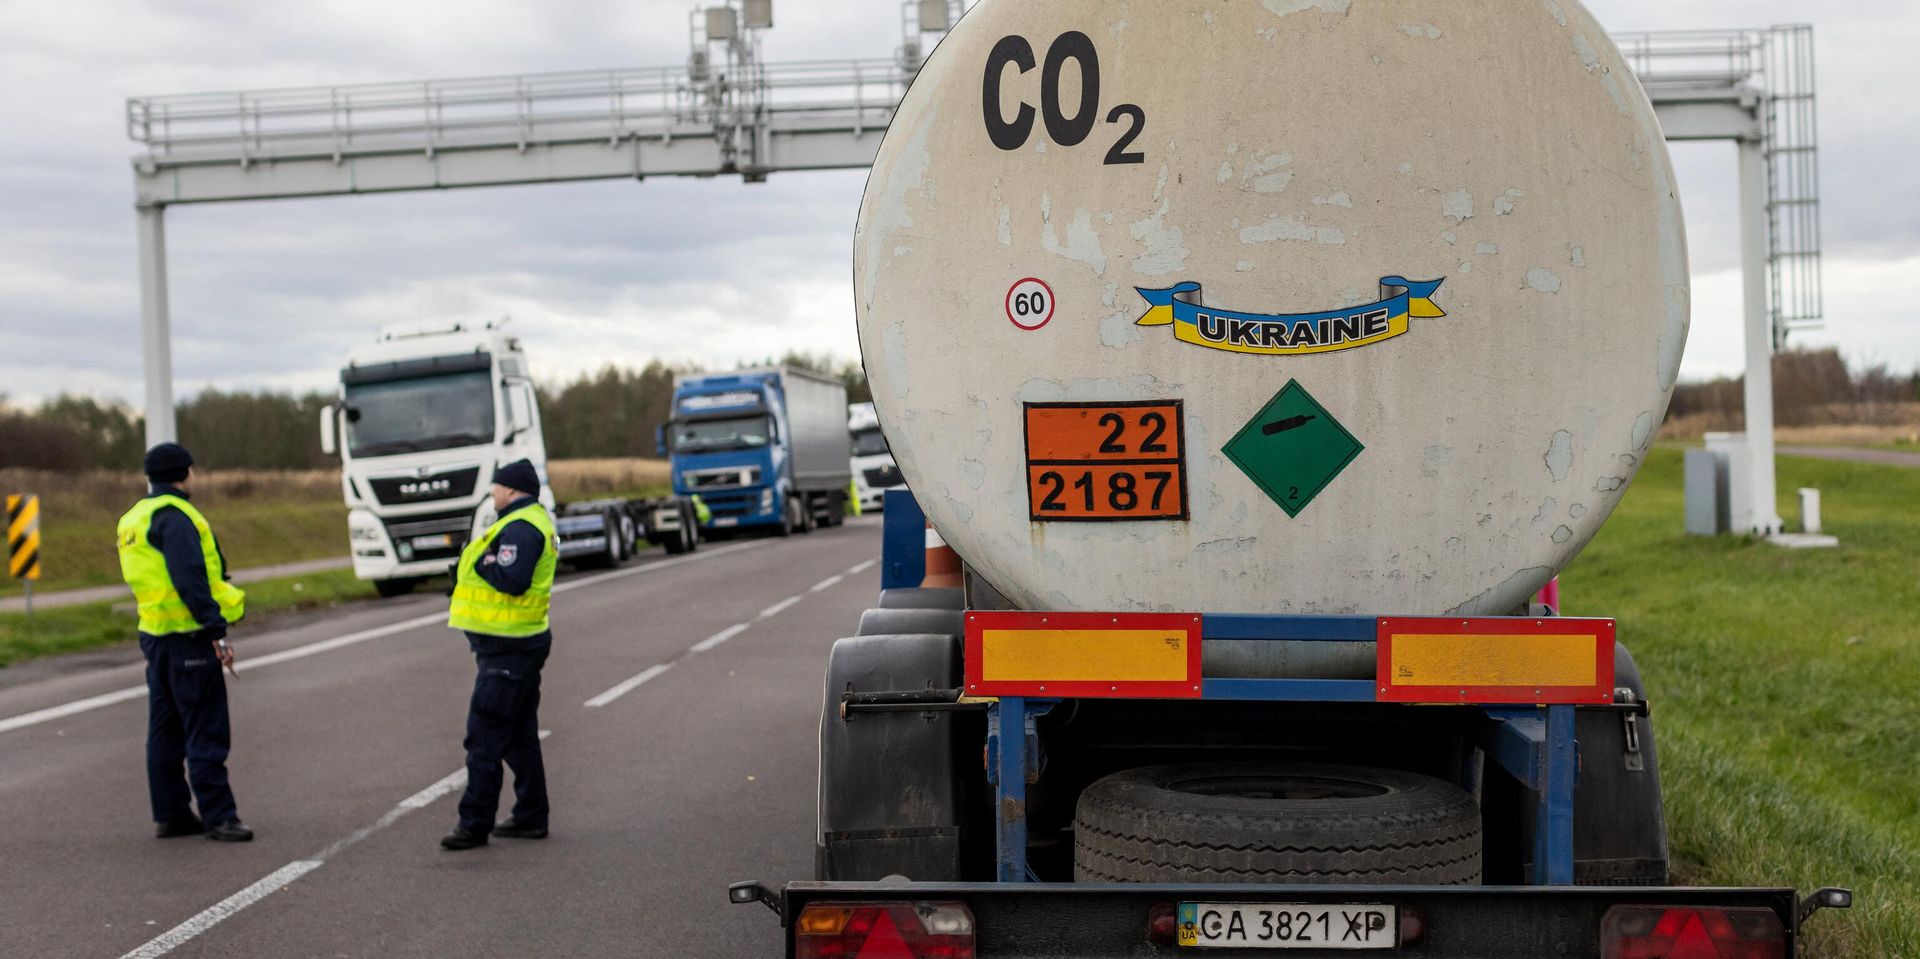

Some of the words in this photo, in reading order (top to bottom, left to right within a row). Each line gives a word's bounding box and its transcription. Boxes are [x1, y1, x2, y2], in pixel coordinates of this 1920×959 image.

[983, 31, 1145, 165] CO2
[1015, 291, 1045, 316] 60
[1196, 308, 1389, 349] UKRAINE
[1098, 412, 1167, 453] 22
[400, 479, 450, 494] MAN
[1038, 471, 1172, 511] 2187
[1288, 486, 1299, 500] 2
[1182, 931, 1196, 940] UA
[1201, 910, 1247, 940] CA
[1257, 911, 1330, 941] 3821
[1342, 911, 1386, 941] XP
